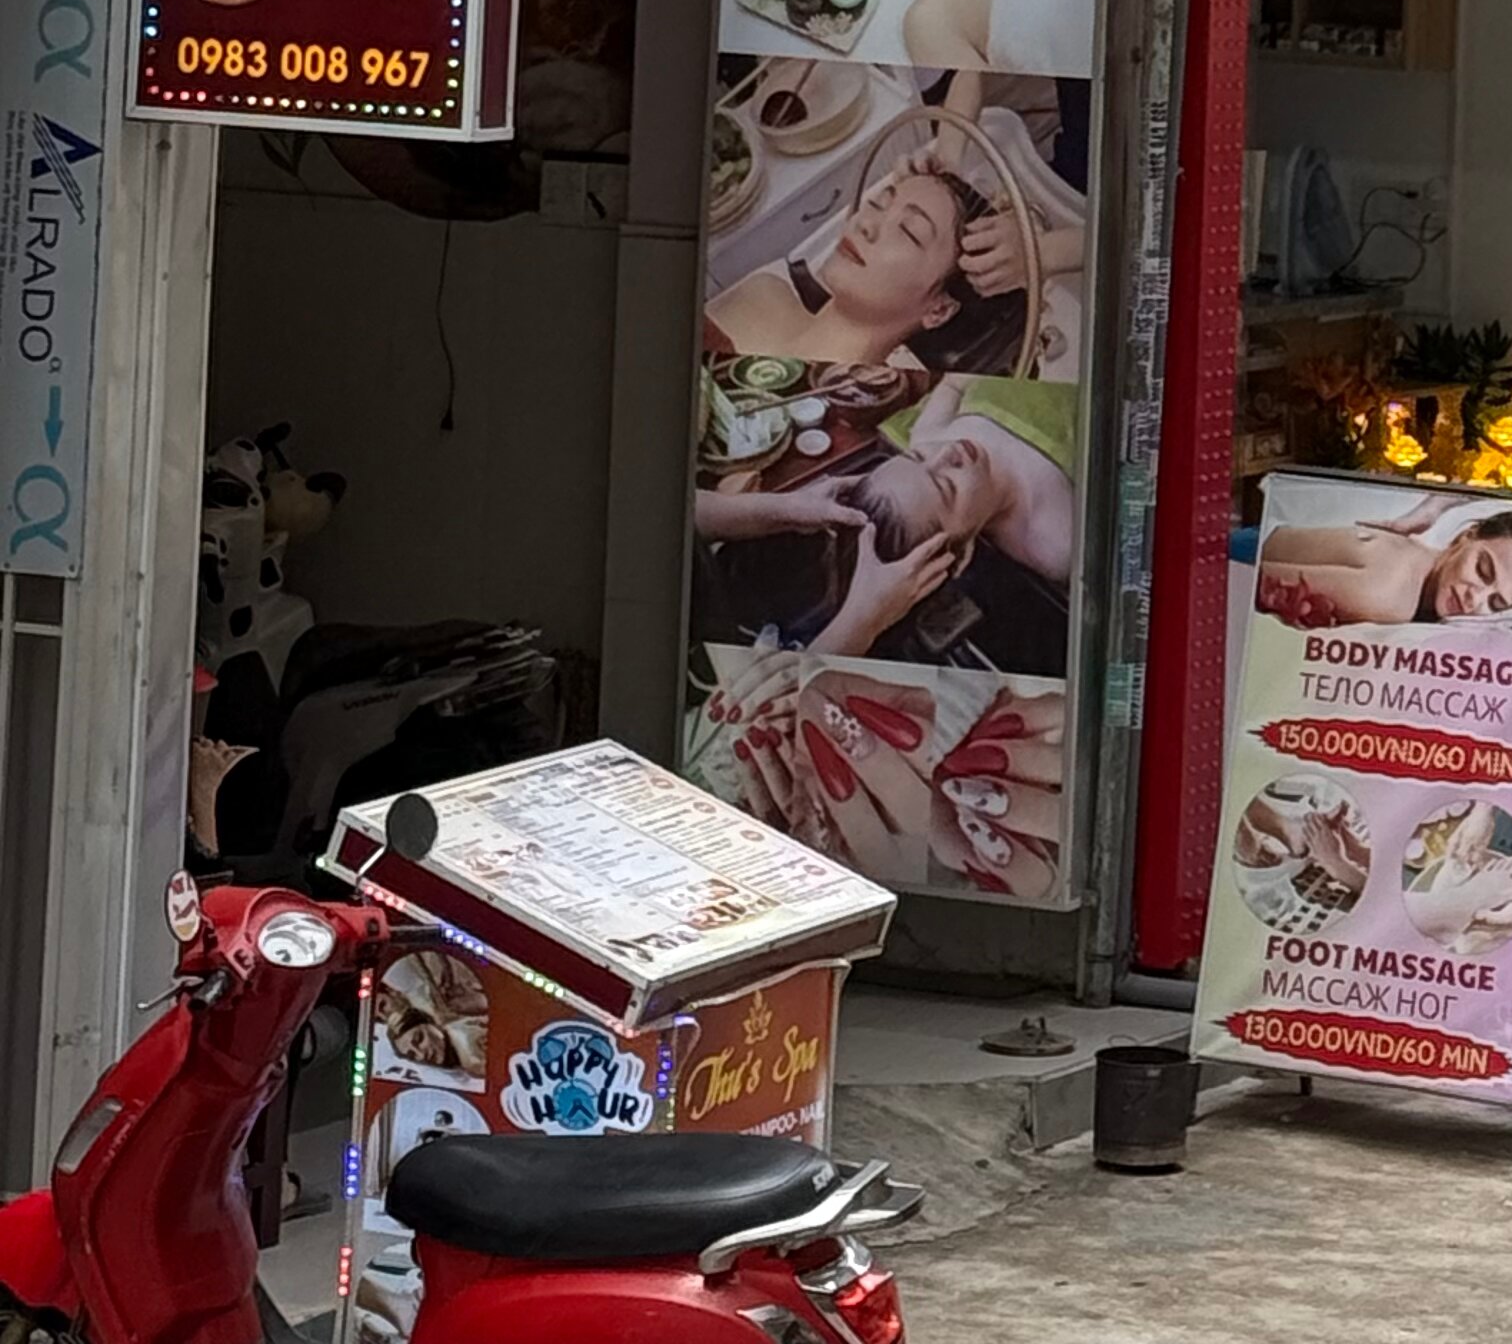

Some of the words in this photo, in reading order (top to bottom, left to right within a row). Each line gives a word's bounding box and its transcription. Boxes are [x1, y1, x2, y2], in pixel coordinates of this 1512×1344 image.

[177, 37, 268, 78] 0983
[281, 43, 349, 82] 008
[361, 48, 430, 89] 967
[1303, 635, 1390, 669] BODY
[1300, 672, 1375, 704] ТЕЛО
[1379, 681, 1508, 724] МАССАЖ
[1265, 935, 1350, 970] FOOT
[1352, 946, 1496, 992] MASSAGE
[1262, 970, 1391, 1013] МАССАЖ
[1396, 989, 1458, 1021] НОГ
[772, 1025, 819, 1104] Spa
[1244, 1012, 1437, 1067] 130.000VND/60
[1440, 1042, 1490, 1076] MIN
